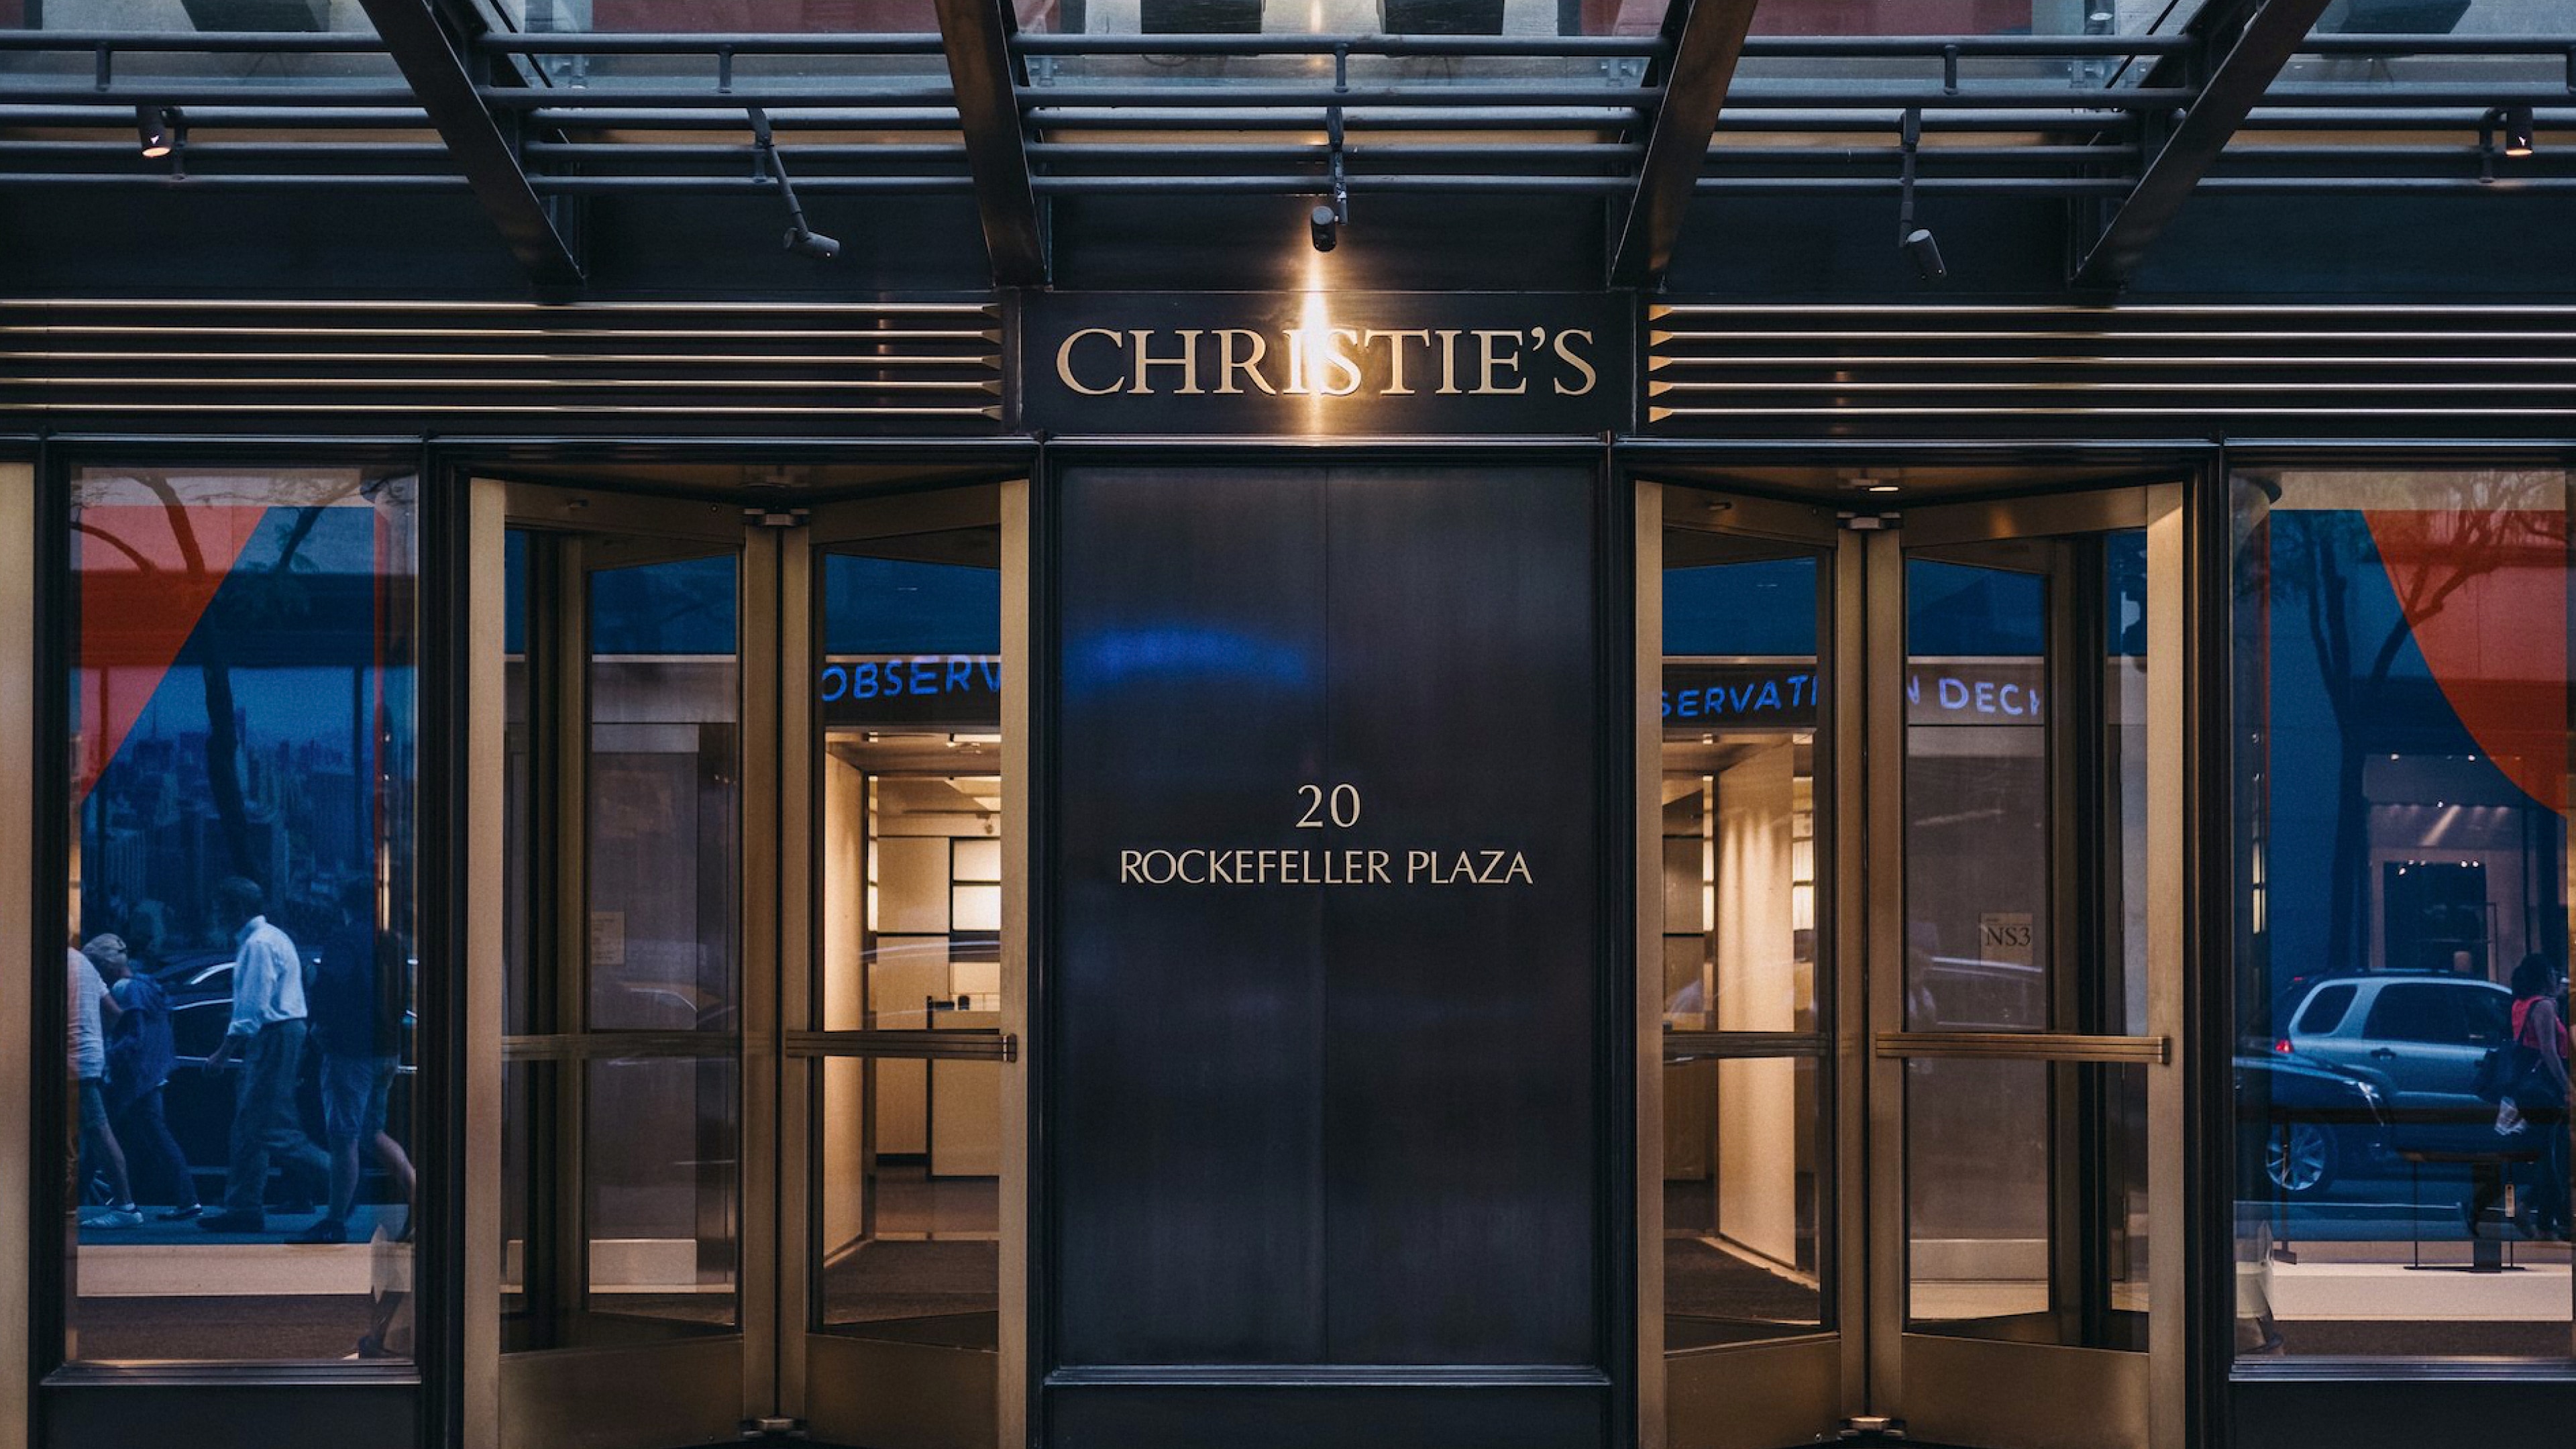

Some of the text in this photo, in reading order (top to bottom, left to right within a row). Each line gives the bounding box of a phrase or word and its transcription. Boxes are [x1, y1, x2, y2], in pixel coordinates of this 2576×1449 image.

[1055, 326, 1597, 396] CHRISTIE’S
[1295, 783, 1361, 828] 20
[1121, 849, 1534, 883] ROCKEFELLER PLAZA
[1985, 926, 2031, 947] NS3
